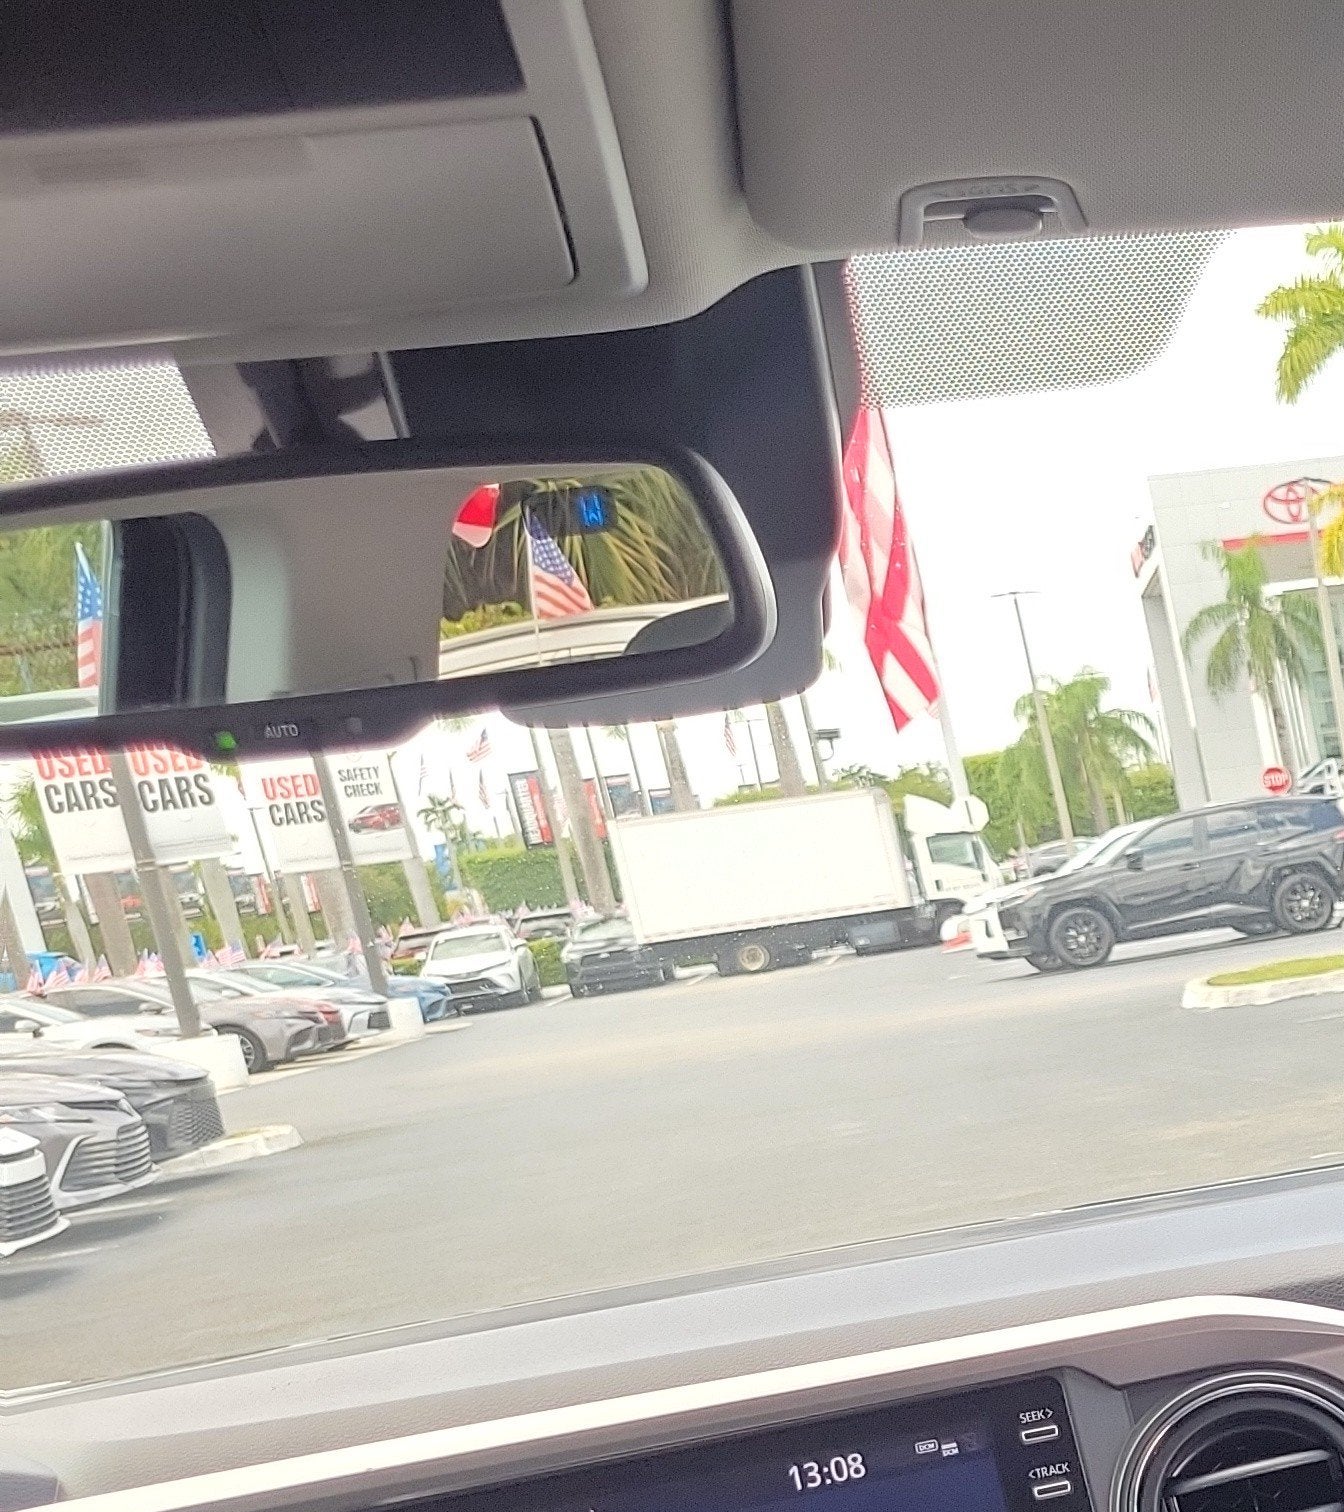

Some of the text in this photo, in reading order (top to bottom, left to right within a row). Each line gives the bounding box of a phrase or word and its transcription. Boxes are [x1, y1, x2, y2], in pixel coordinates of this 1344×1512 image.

[264, 724, 299, 739] AUTO
[31, 747, 112, 781] USED
[125, 740, 205, 777] USED
[337, 765, 379, 783] SAFETY
[44, 777, 120, 814] CARS
[137, 773, 216, 813] CARS
[261, 772, 321, 801] USED
[344, 782, 383, 798] CHECK
[268, 799, 327, 827] CARS
[788, 1453, 867, 1491] 13:08
